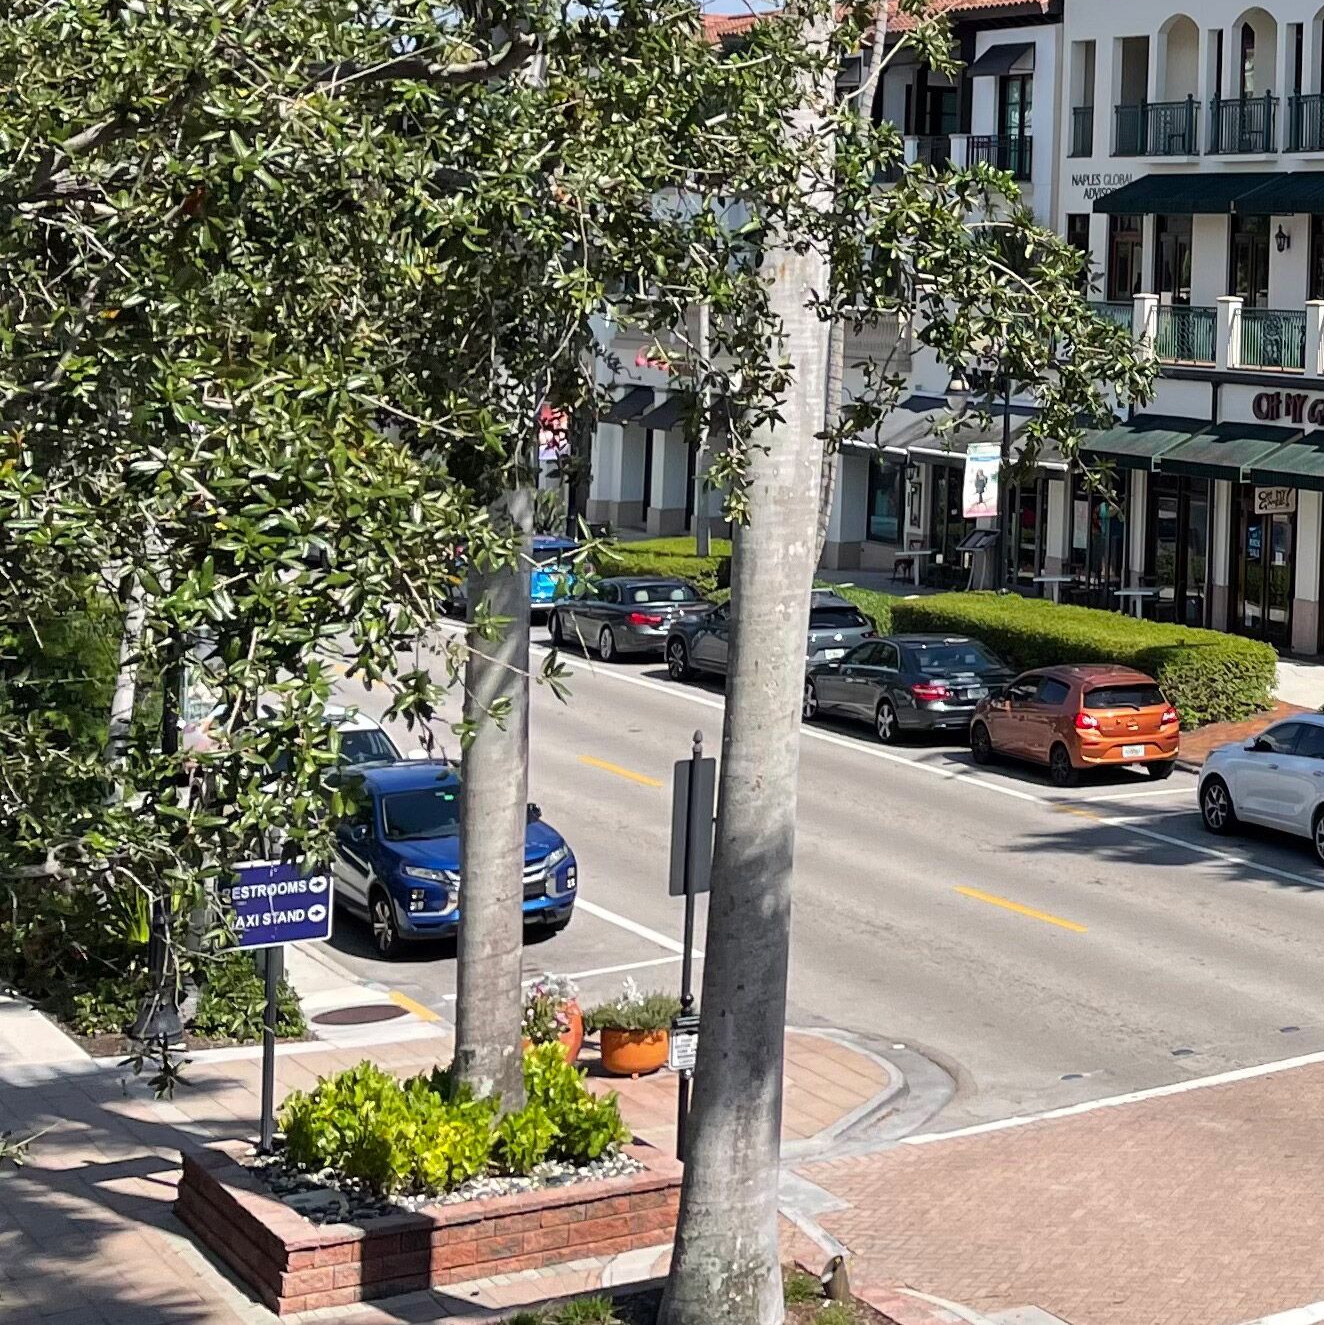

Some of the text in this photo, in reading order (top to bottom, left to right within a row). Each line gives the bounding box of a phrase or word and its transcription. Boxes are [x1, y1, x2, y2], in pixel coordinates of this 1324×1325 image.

[1072, 174, 1132, 186] NAPLES GLOBAL
[1252, 392, 1282, 421] OH
[1285, 393, 1308, 423] MY
[233, 909, 306, 930] AXI STAND
